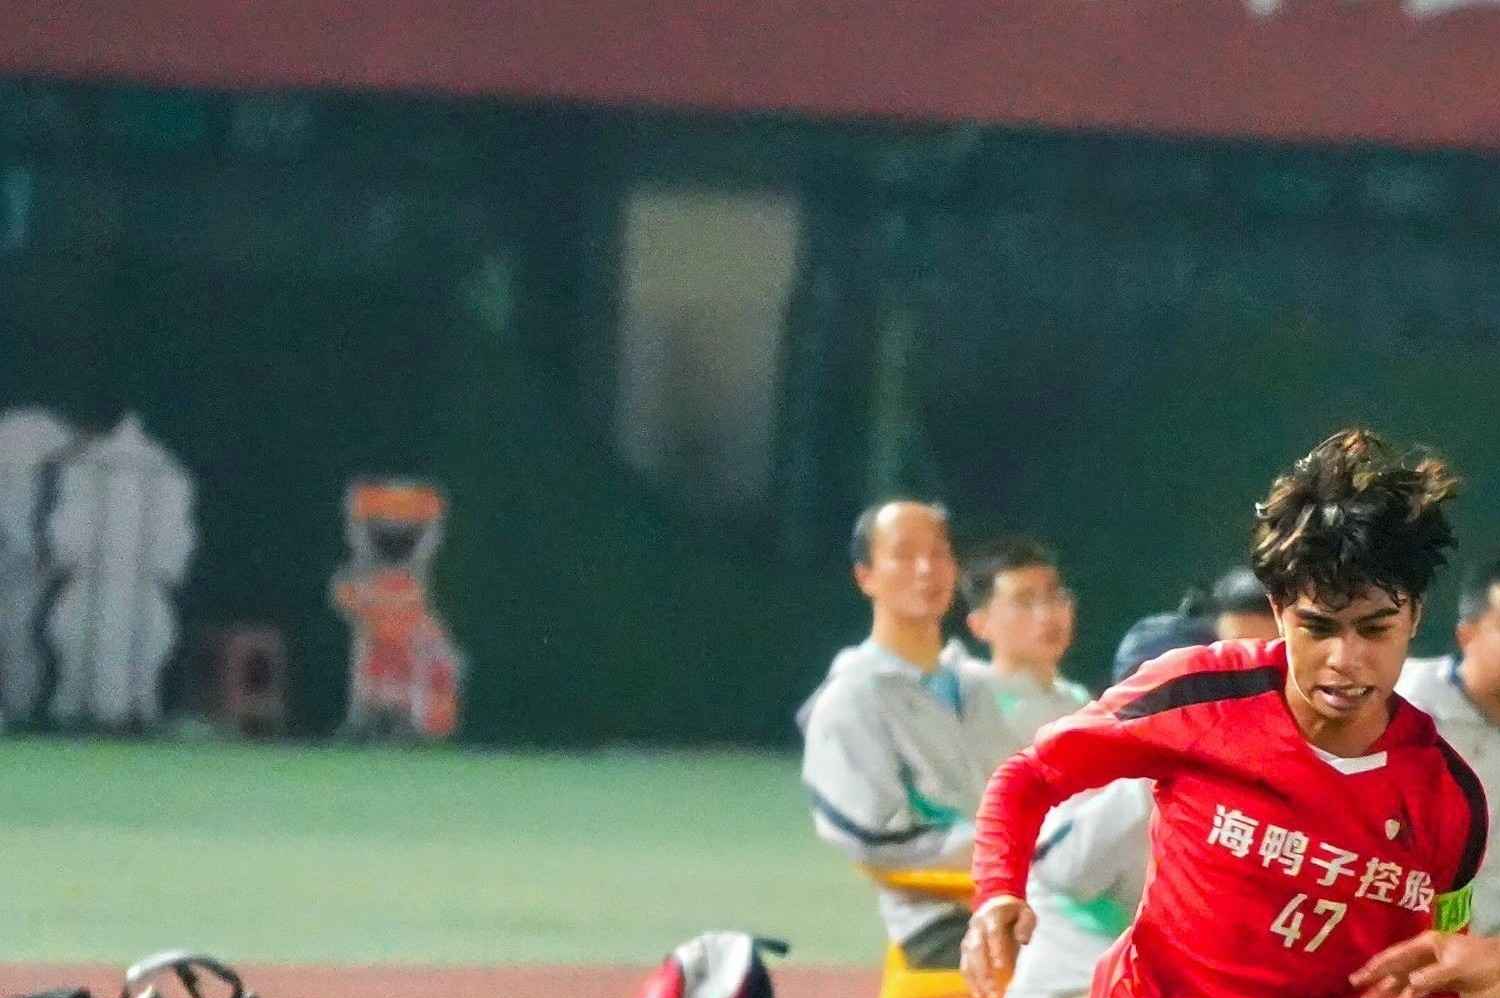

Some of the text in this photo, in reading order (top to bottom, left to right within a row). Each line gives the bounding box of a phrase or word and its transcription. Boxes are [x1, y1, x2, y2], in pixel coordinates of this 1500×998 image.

[1207, 804, 1436, 913] 海鸭子控股
[1270, 893, 1347, 953] 47
